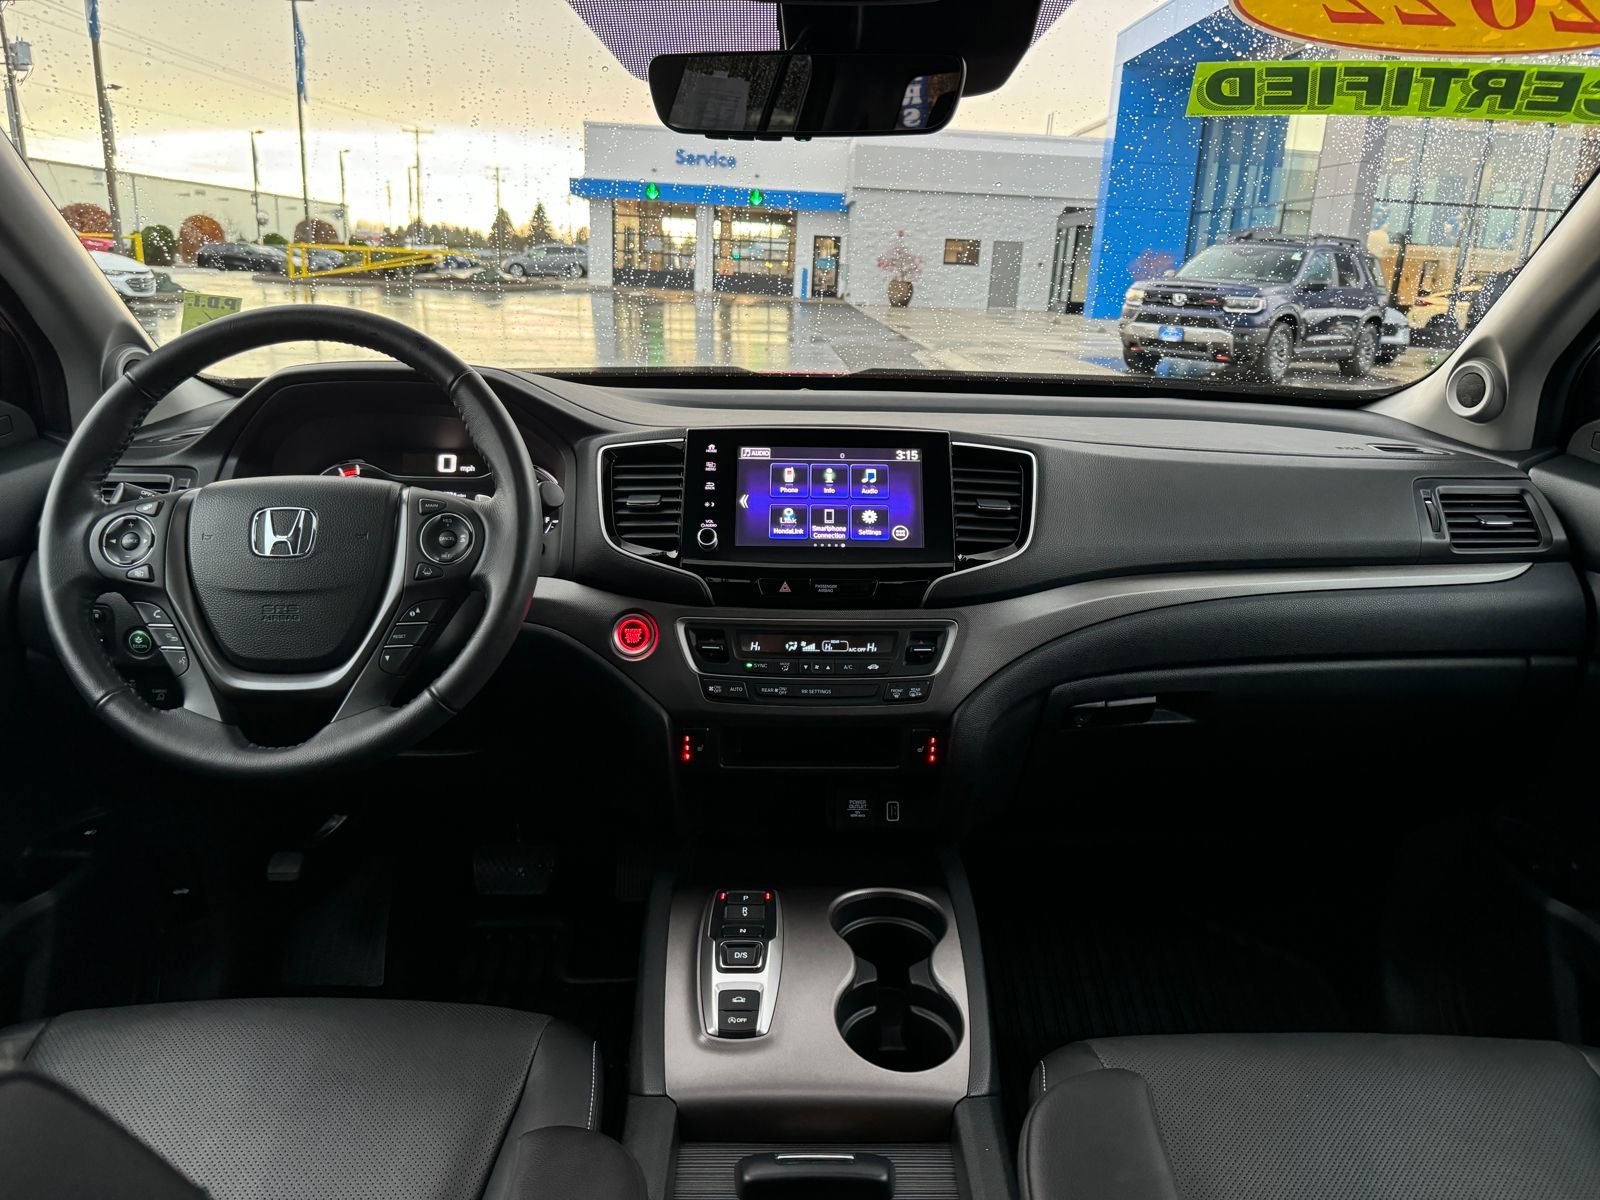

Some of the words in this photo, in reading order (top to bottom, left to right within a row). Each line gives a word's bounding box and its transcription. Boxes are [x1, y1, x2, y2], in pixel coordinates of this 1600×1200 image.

[676, 149, 736, 168] Service
[895, 450, 919, 461] 3:15
[438, 455, 457, 473] 0
[459, 464, 476, 472] mph
[779, 486, 799, 494] Phone
[811, 525, 847, 533] Smartphone
[858, 528, 882, 537] Settings
[261, 604, 300, 614] SRS
